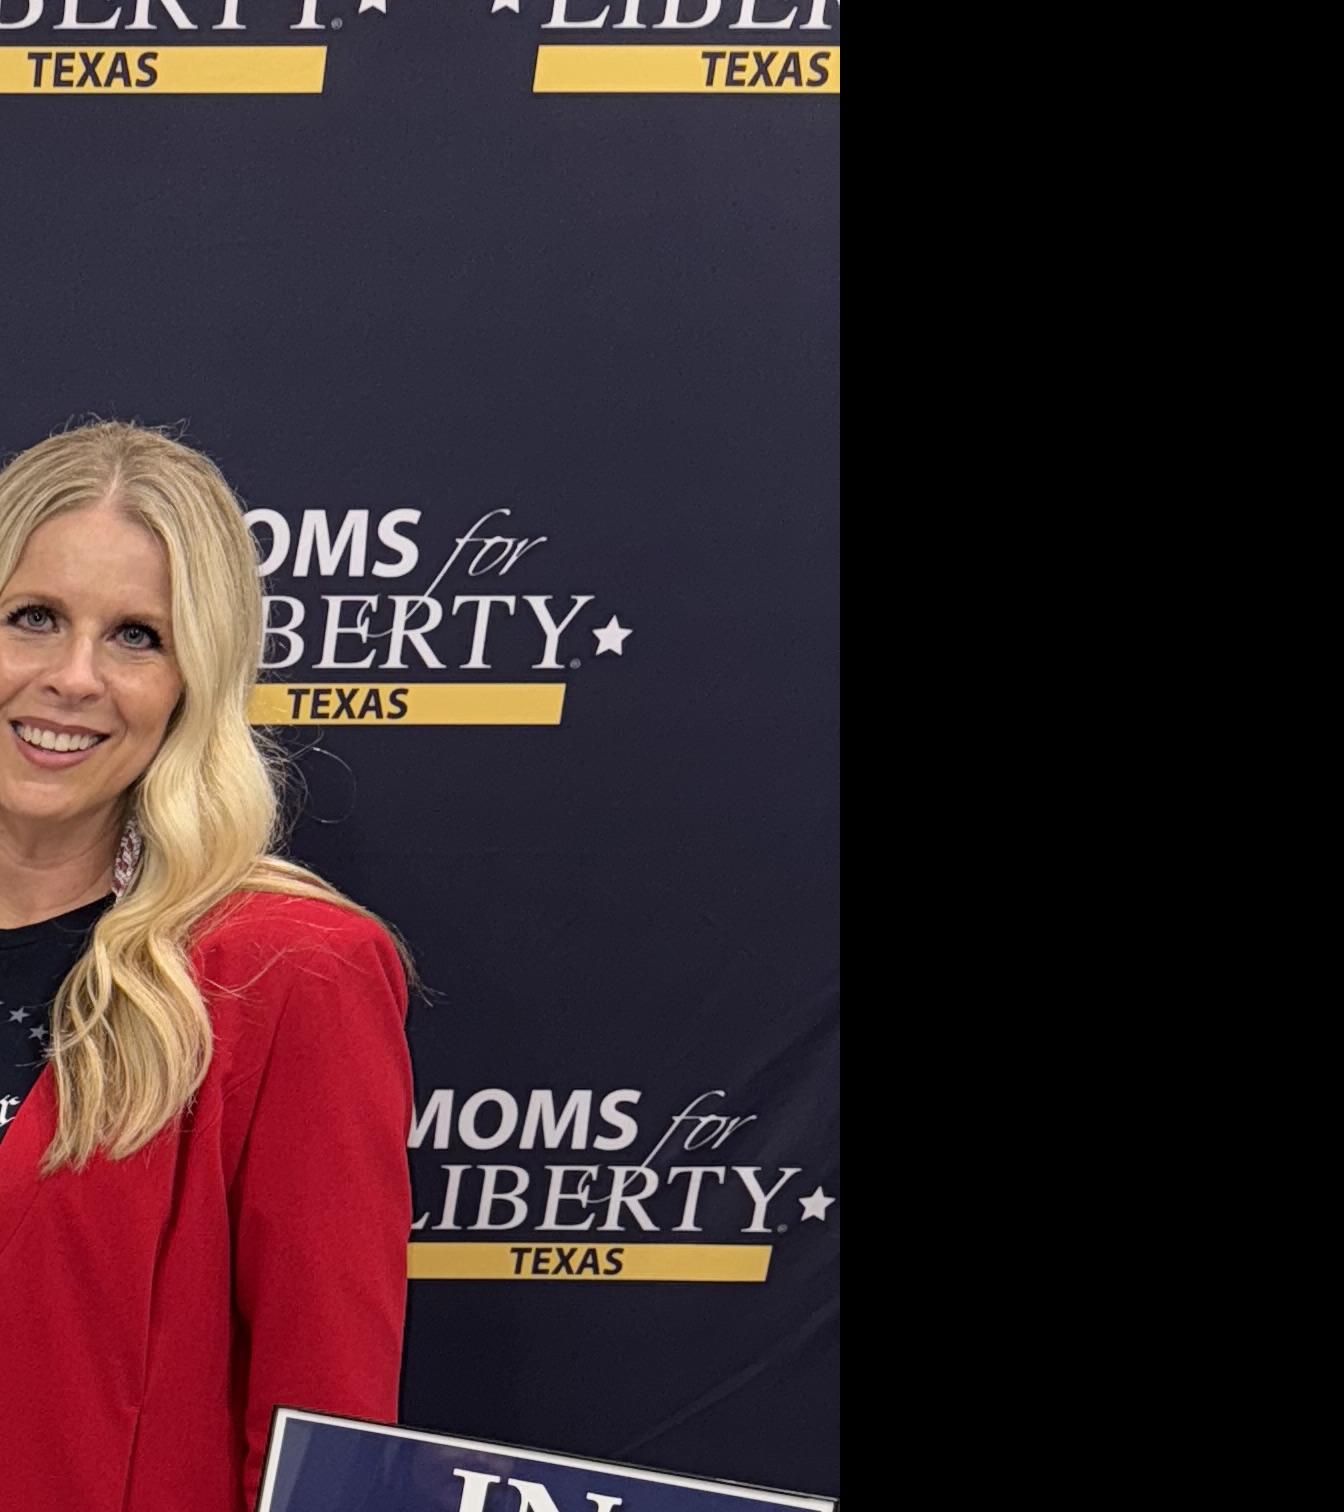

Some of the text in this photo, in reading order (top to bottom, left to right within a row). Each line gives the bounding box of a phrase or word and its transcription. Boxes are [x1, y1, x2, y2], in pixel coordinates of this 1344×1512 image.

[26, 51, 158, 89] TEXAS
[701, 49, 830, 89] TEXAS
[243, 509, 421, 577] OMS
[257, 595, 594, 669] BERTY
[287, 688, 408, 719] TEXAS
[410, 1164, 802, 1233] IBERTY
[510, 1247, 624, 1275] TEXAS
